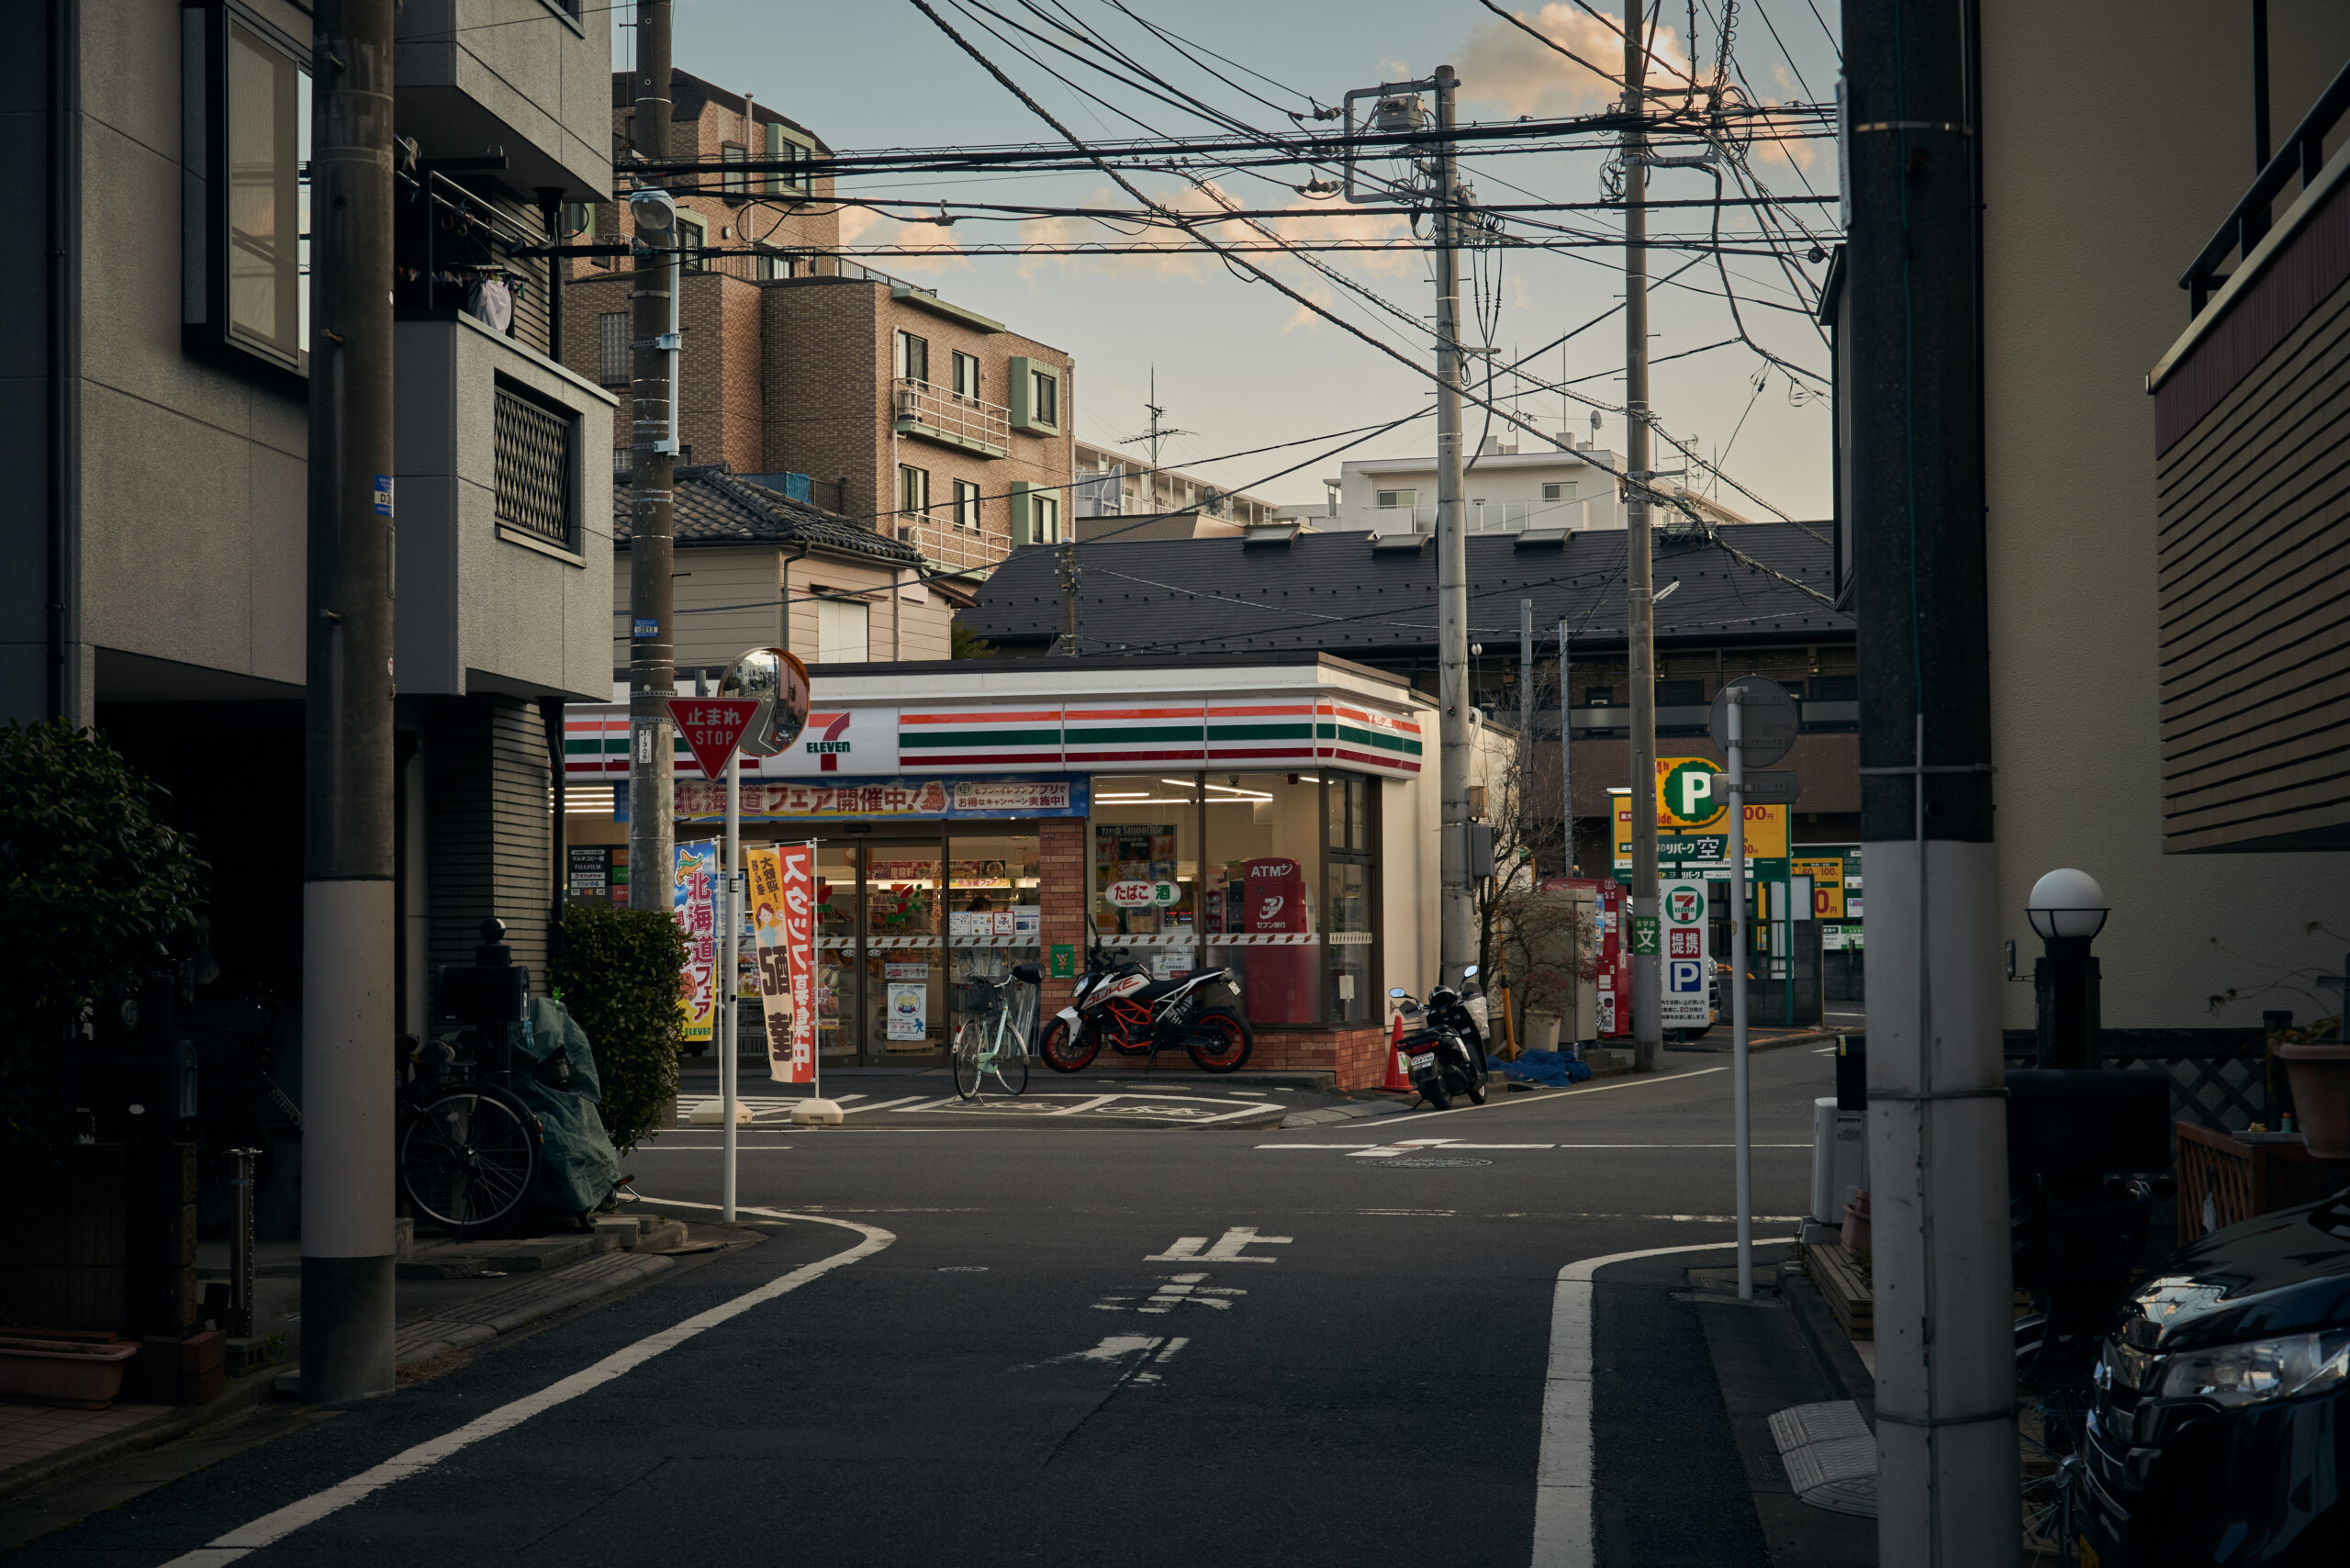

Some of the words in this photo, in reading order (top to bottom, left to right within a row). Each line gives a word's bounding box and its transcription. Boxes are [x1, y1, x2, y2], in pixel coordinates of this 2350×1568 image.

[686, 708, 742, 726] 止まれ
[696, 730, 734, 745] STOP
[1656, 761, 1669, 774] 4h
[1682, 771, 1711, 814] P
[1657, 813, 1672, 824] ide
[1743, 806, 1774, 820] 00円
[1102, 827, 1121, 835] Fresh
[1123, 826, 1164, 835] Smoothie
[1697, 836, 1719, 859] 空
[1250, 866, 1281, 878] ATM
[1114, 884, 1149, 901] たばこ
[1155, 884, 1170, 901] 酒
[688, 871, 714, 1021] 北海道フェア
[1637, 927, 1655, 948] 文
[1671, 932, 1699, 955] 提携
[1673, 962, 1699, 991] P
